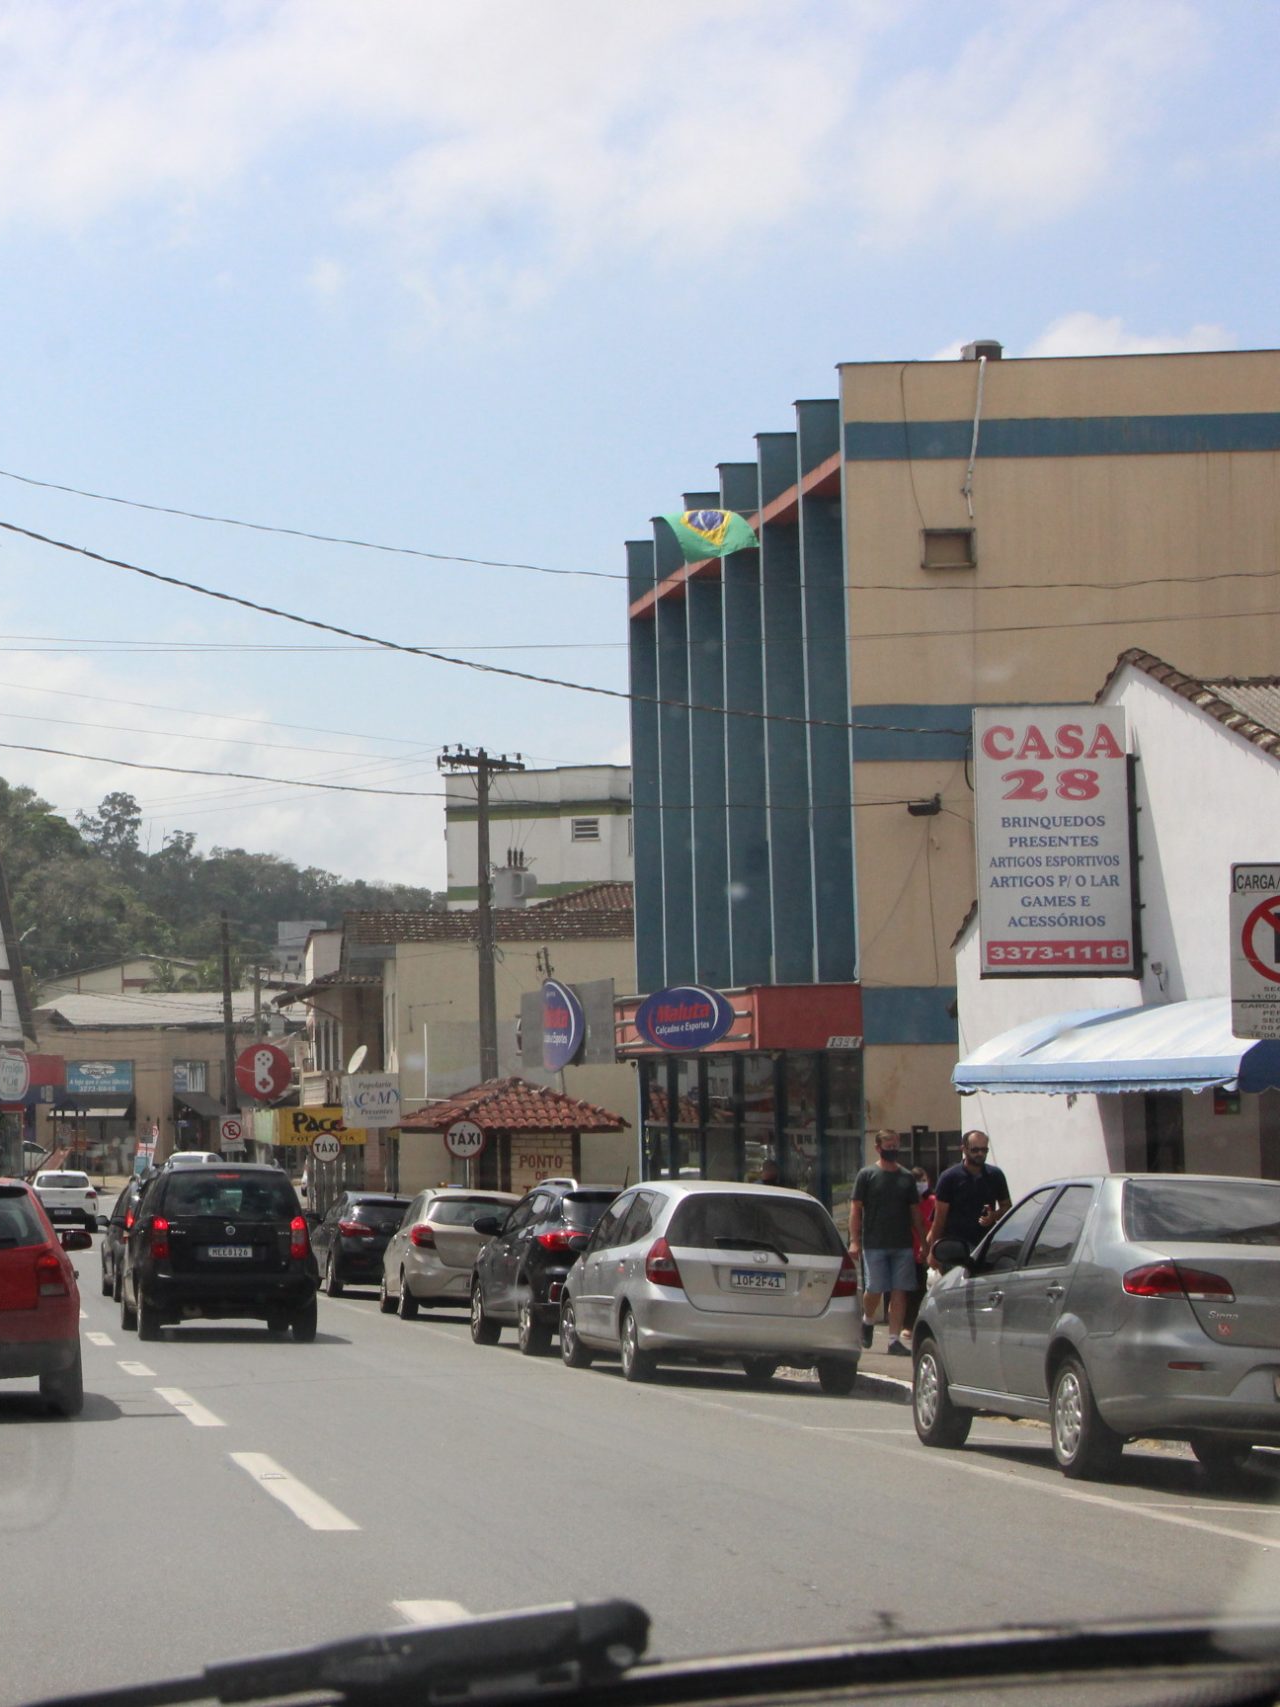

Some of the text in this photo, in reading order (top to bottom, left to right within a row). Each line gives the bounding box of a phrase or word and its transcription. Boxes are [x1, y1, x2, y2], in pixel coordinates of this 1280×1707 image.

[981, 724, 1125, 760] CASA
[1001, 768, 1101, 802] 28
[1001, 815, 1106, 829] BRINQUEDOS
[1008, 835, 1099, 848] PRESENTES
[989, 855, 1120, 868] ARTIGOS ESPORTIVOS
[989, 875, 1055, 888] ARTIGOS
[1076, 875, 1086, 887] O
[1091, 875, 1120, 887] LAR
[1021, 895, 1091, 907] GAMES E
[1008, 913, 1106, 927] ACESSÓRIOS
[990, 946, 1127, 960] 3373-1118
[657, 1003, 711, 1022] Maluta
[655, 1024, 680, 1036] Calçados
[684, 1021, 710, 1033] Esportes
[449, 1129, 481, 1145] TÁXI
[315, 1140, 339, 1153] TÁXI
[519, 1154, 563, 1169] PONTO
